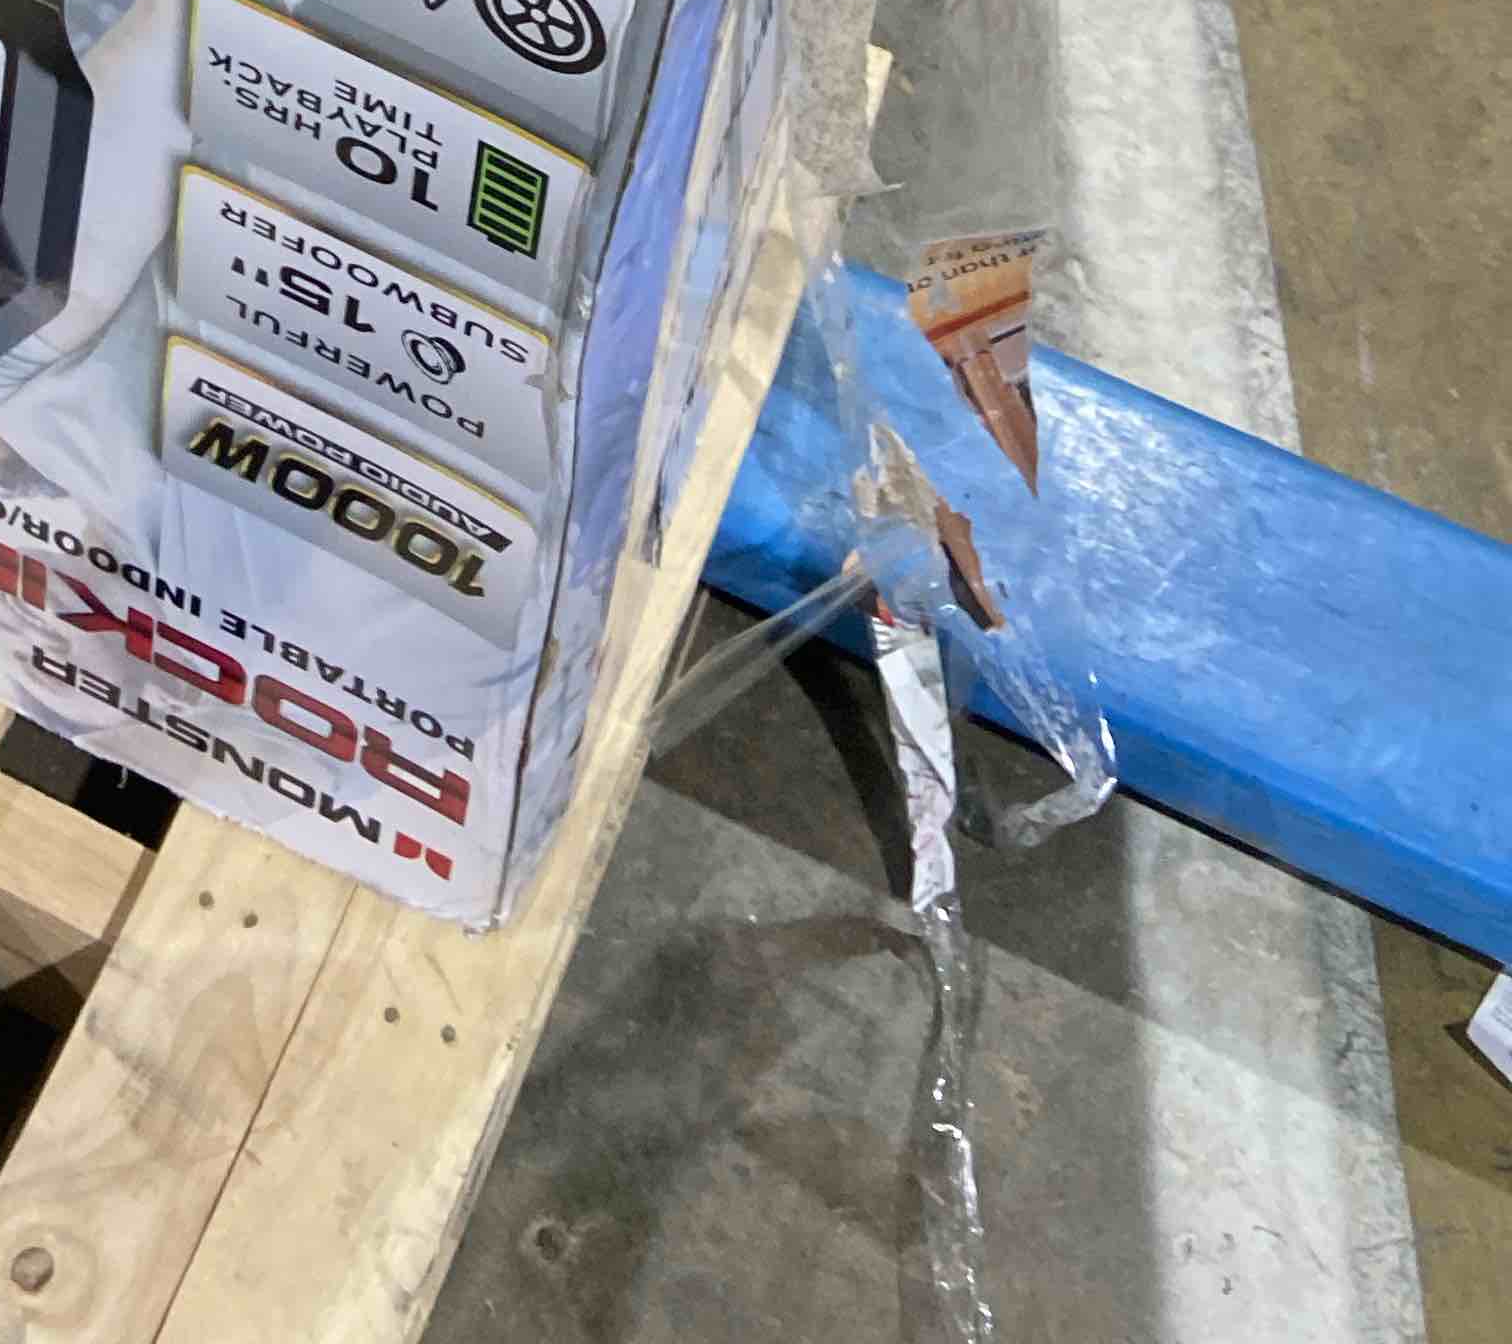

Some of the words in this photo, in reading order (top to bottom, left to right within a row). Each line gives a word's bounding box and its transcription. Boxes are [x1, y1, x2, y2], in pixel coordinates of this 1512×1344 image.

[207, 47, 438, 170] PLAYBACK
[223, 79, 321, 140] HRS.
[334, 79, 442, 147] TIME
[335, 136, 439, 212] 10
[219, 202, 529, 363] SUBWOOFER
[200, 381, 354, 463] POWER
[225, 295, 486, 438] POWERFUL
[189, 417, 486, 598] 1000W
[359, 454, 492, 538] AUDIO
[30, 645, 381, 844] MONSTER
[220, 607, 476, 761] PORTABLE
